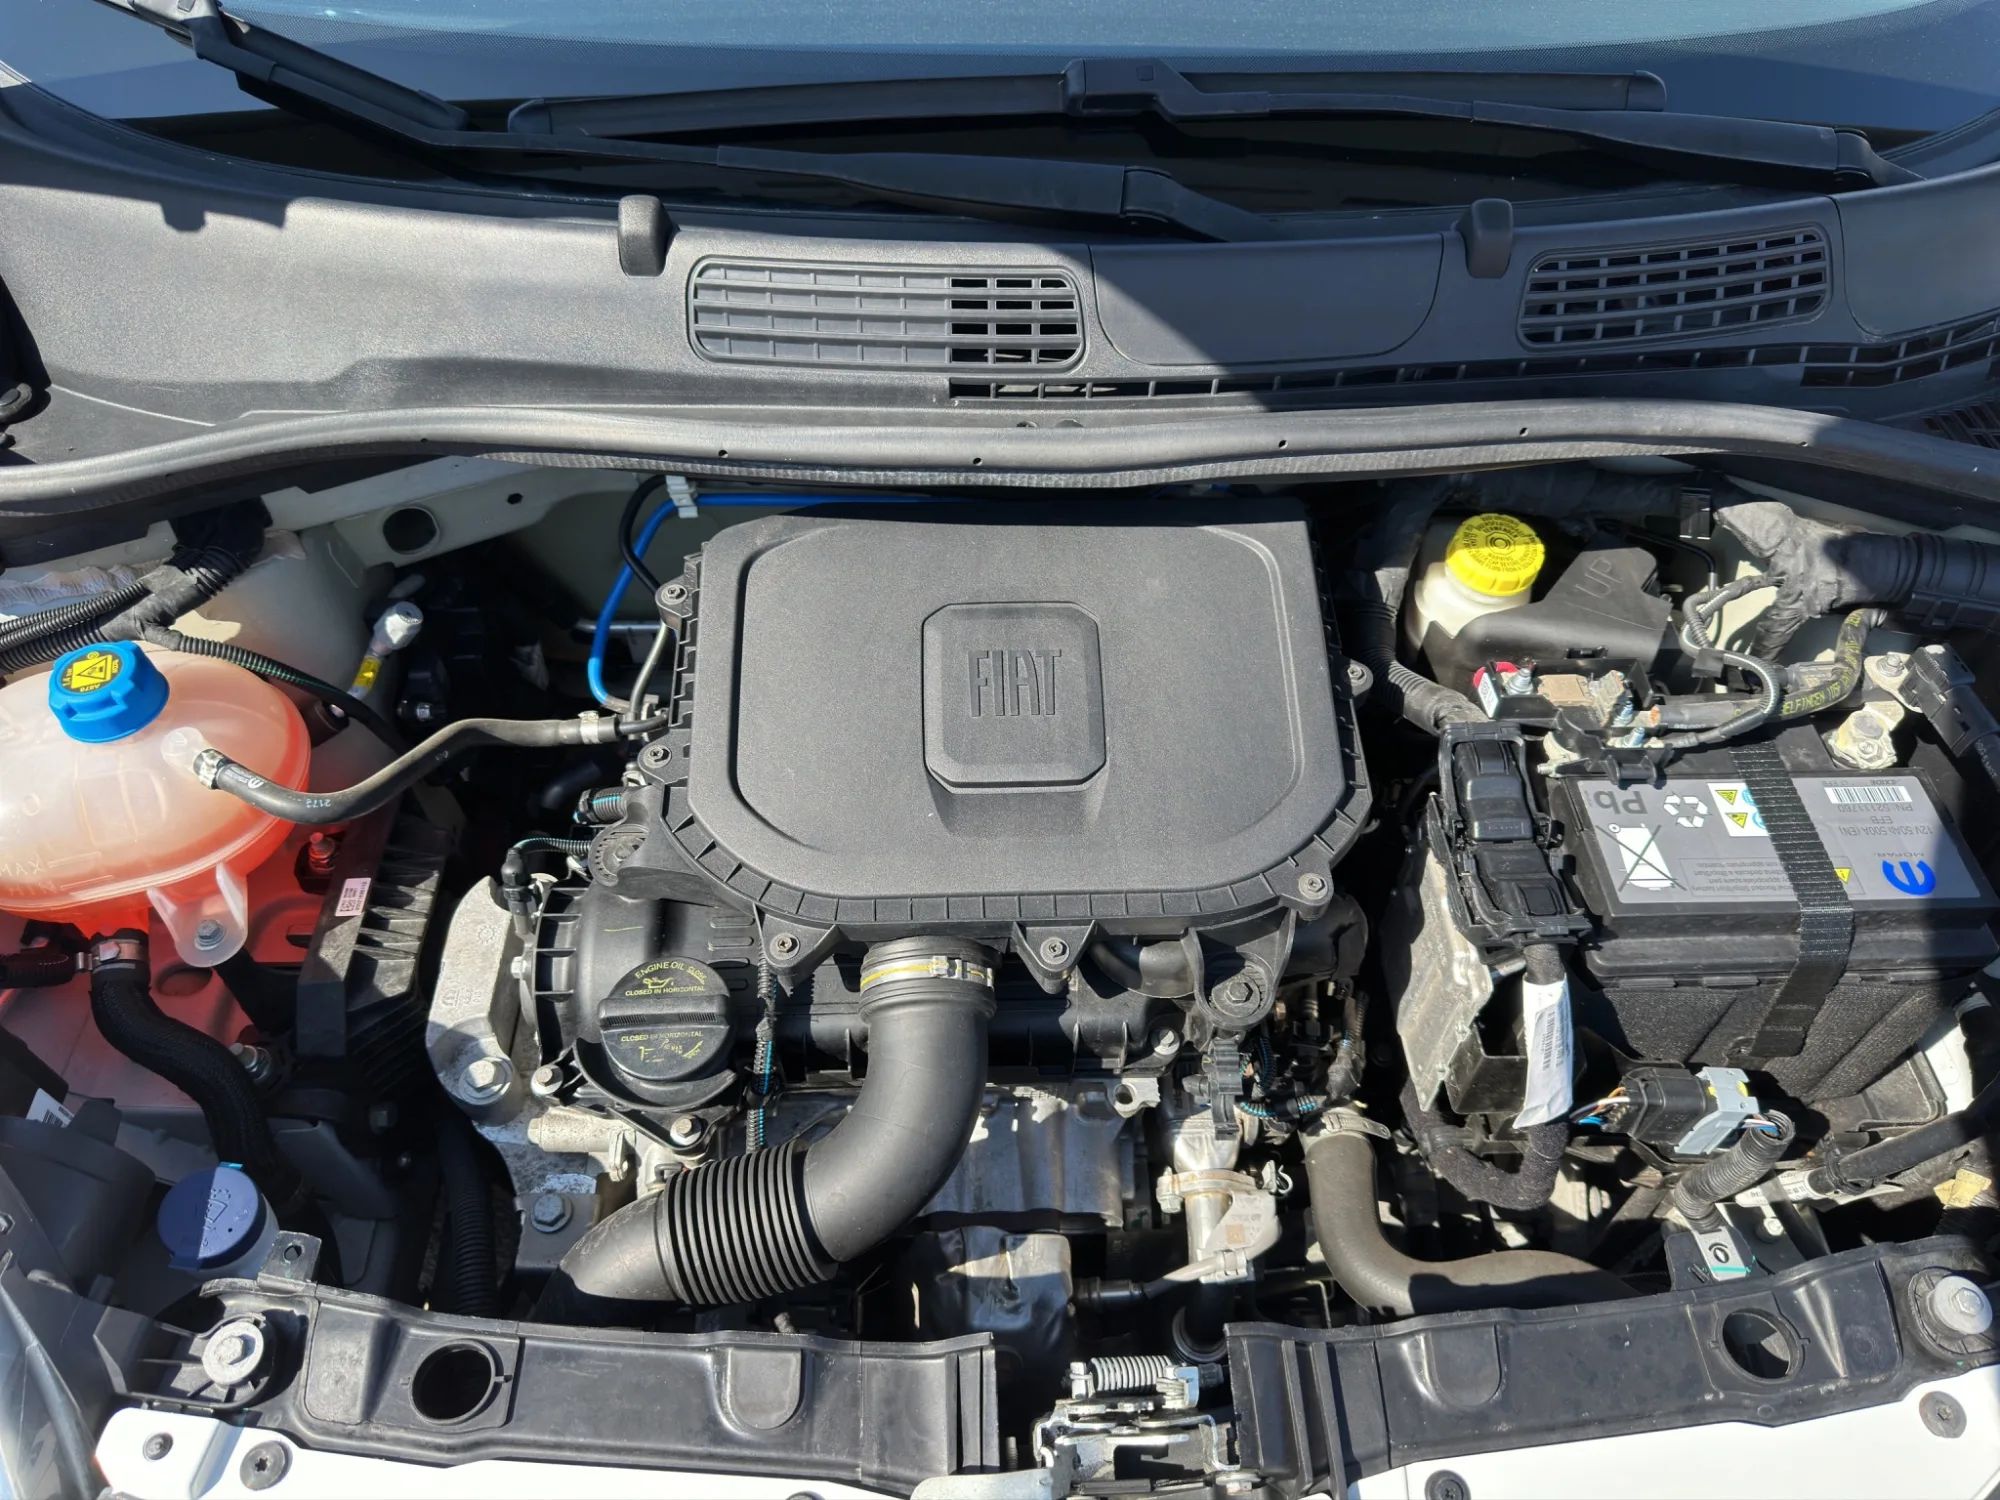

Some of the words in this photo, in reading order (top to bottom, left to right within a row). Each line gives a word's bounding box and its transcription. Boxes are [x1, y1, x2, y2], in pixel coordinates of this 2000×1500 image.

[1575, 556, 1623, 599] UP
[967, 649, 1062, 717] FIAT
[1593, 790, 1648, 814] Pb
[635, 961, 669, 979] ENGINE
[670, 961, 684, 971] OIL
[625, 988, 652, 996] CLOSED
[663, 985, 705, 993] HORIZONTAL
[621, 1034, 648, 1042] CLOSED
